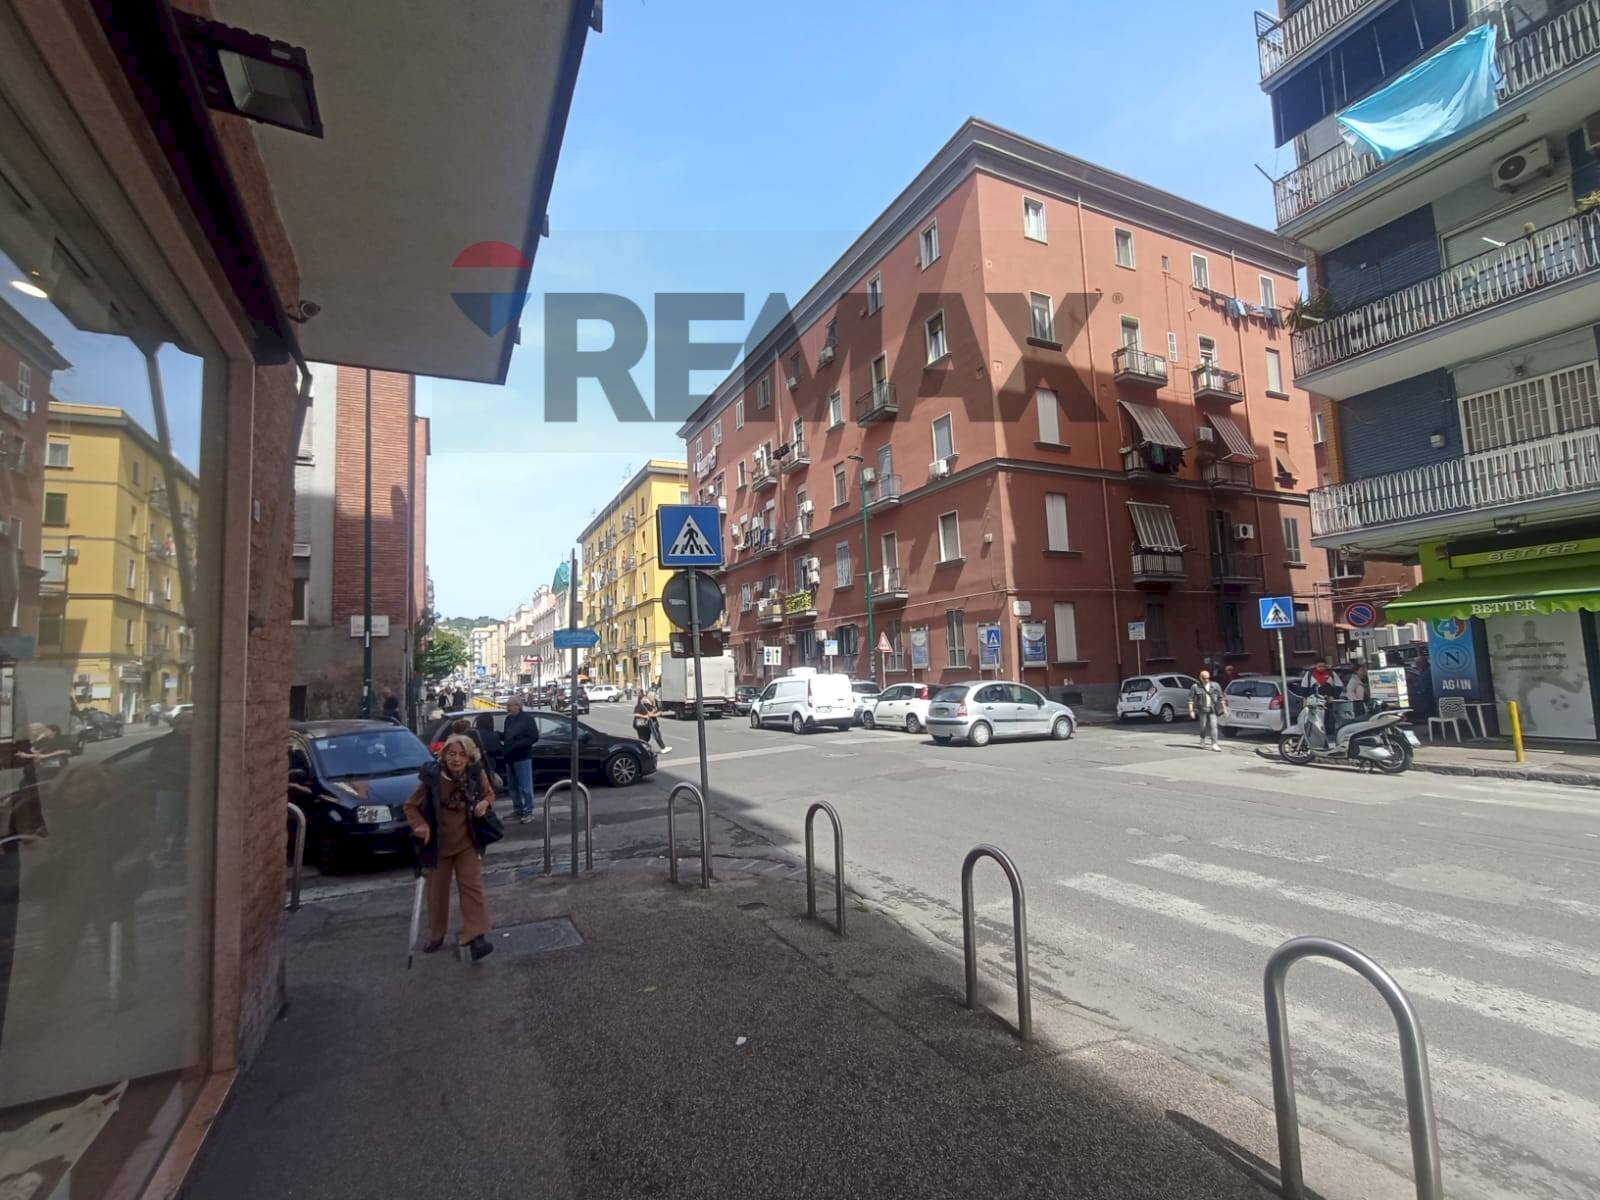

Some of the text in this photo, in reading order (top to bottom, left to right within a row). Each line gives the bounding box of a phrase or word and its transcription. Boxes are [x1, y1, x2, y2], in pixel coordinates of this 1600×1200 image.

[1488, 543, 1579, 561] BETTER
[1471, 599, 1537, 615] BETTER
[1444, 651, 1460, 665] N
